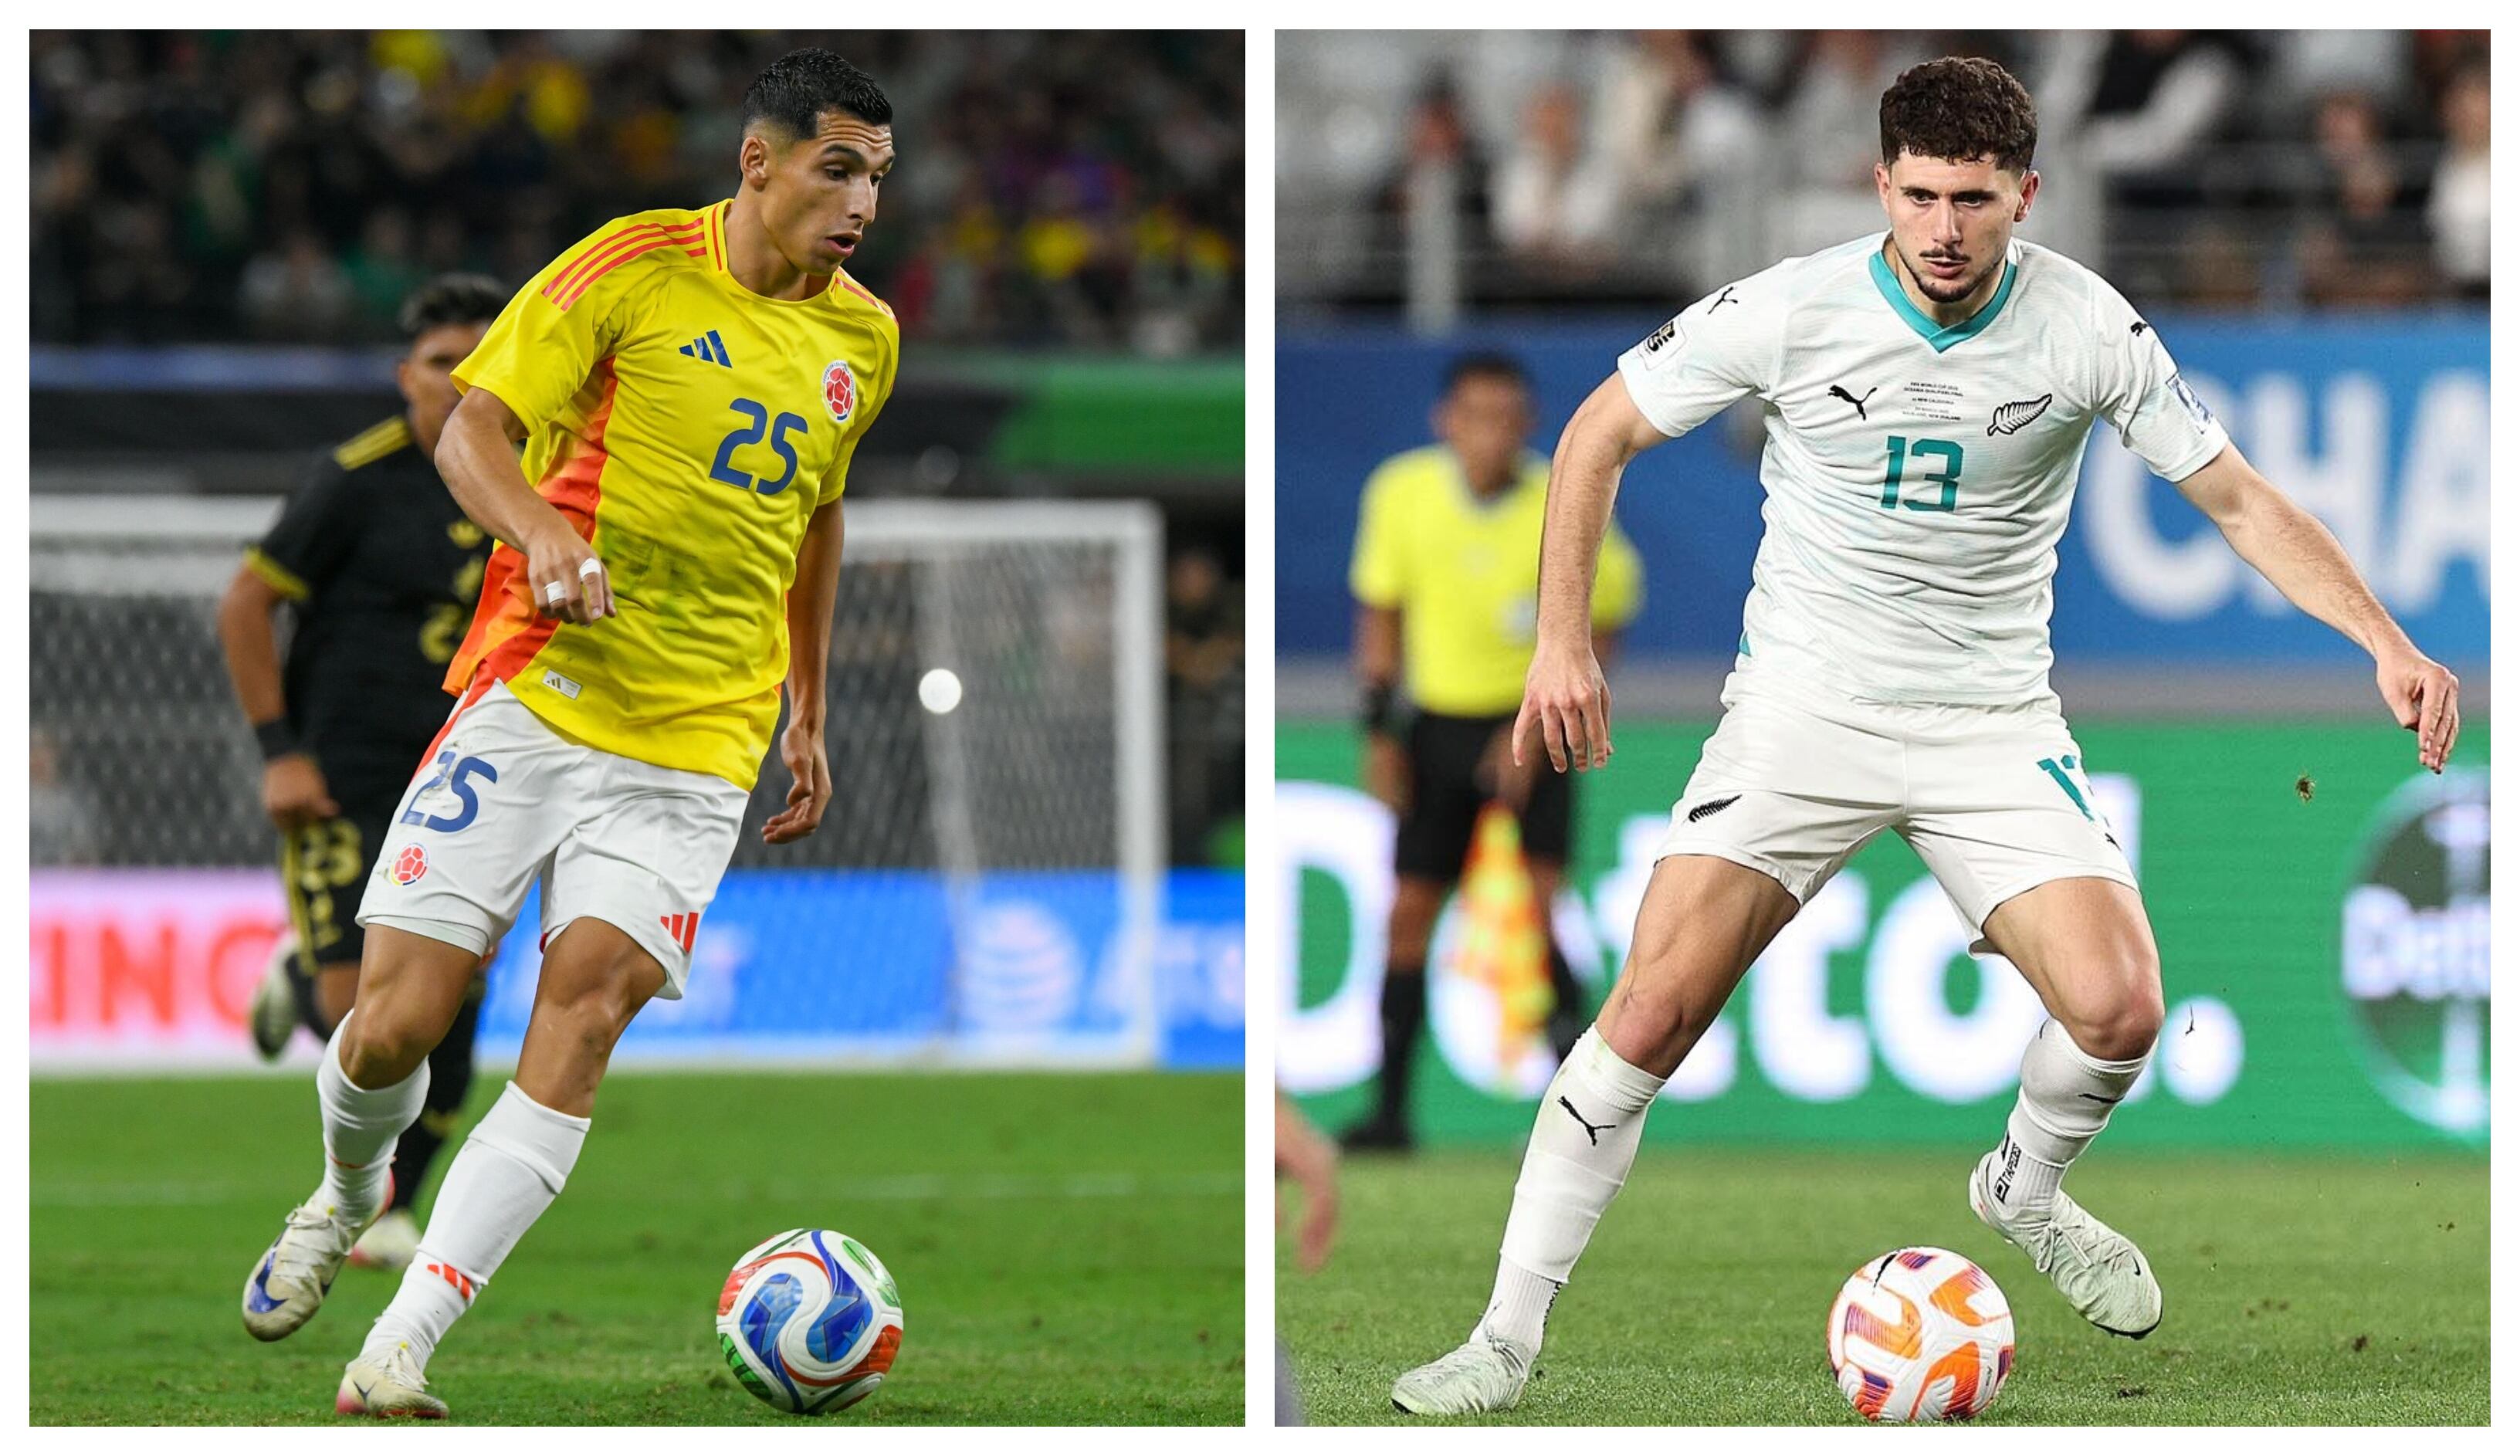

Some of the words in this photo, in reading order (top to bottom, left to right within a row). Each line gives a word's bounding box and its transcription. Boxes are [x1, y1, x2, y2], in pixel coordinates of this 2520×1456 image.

[709, 398, 808, 496] 25
[1881, 435, 1964, 512] 13
[399, 751, 498, 833] 25
[2037, 754, 2095, 822] 1
